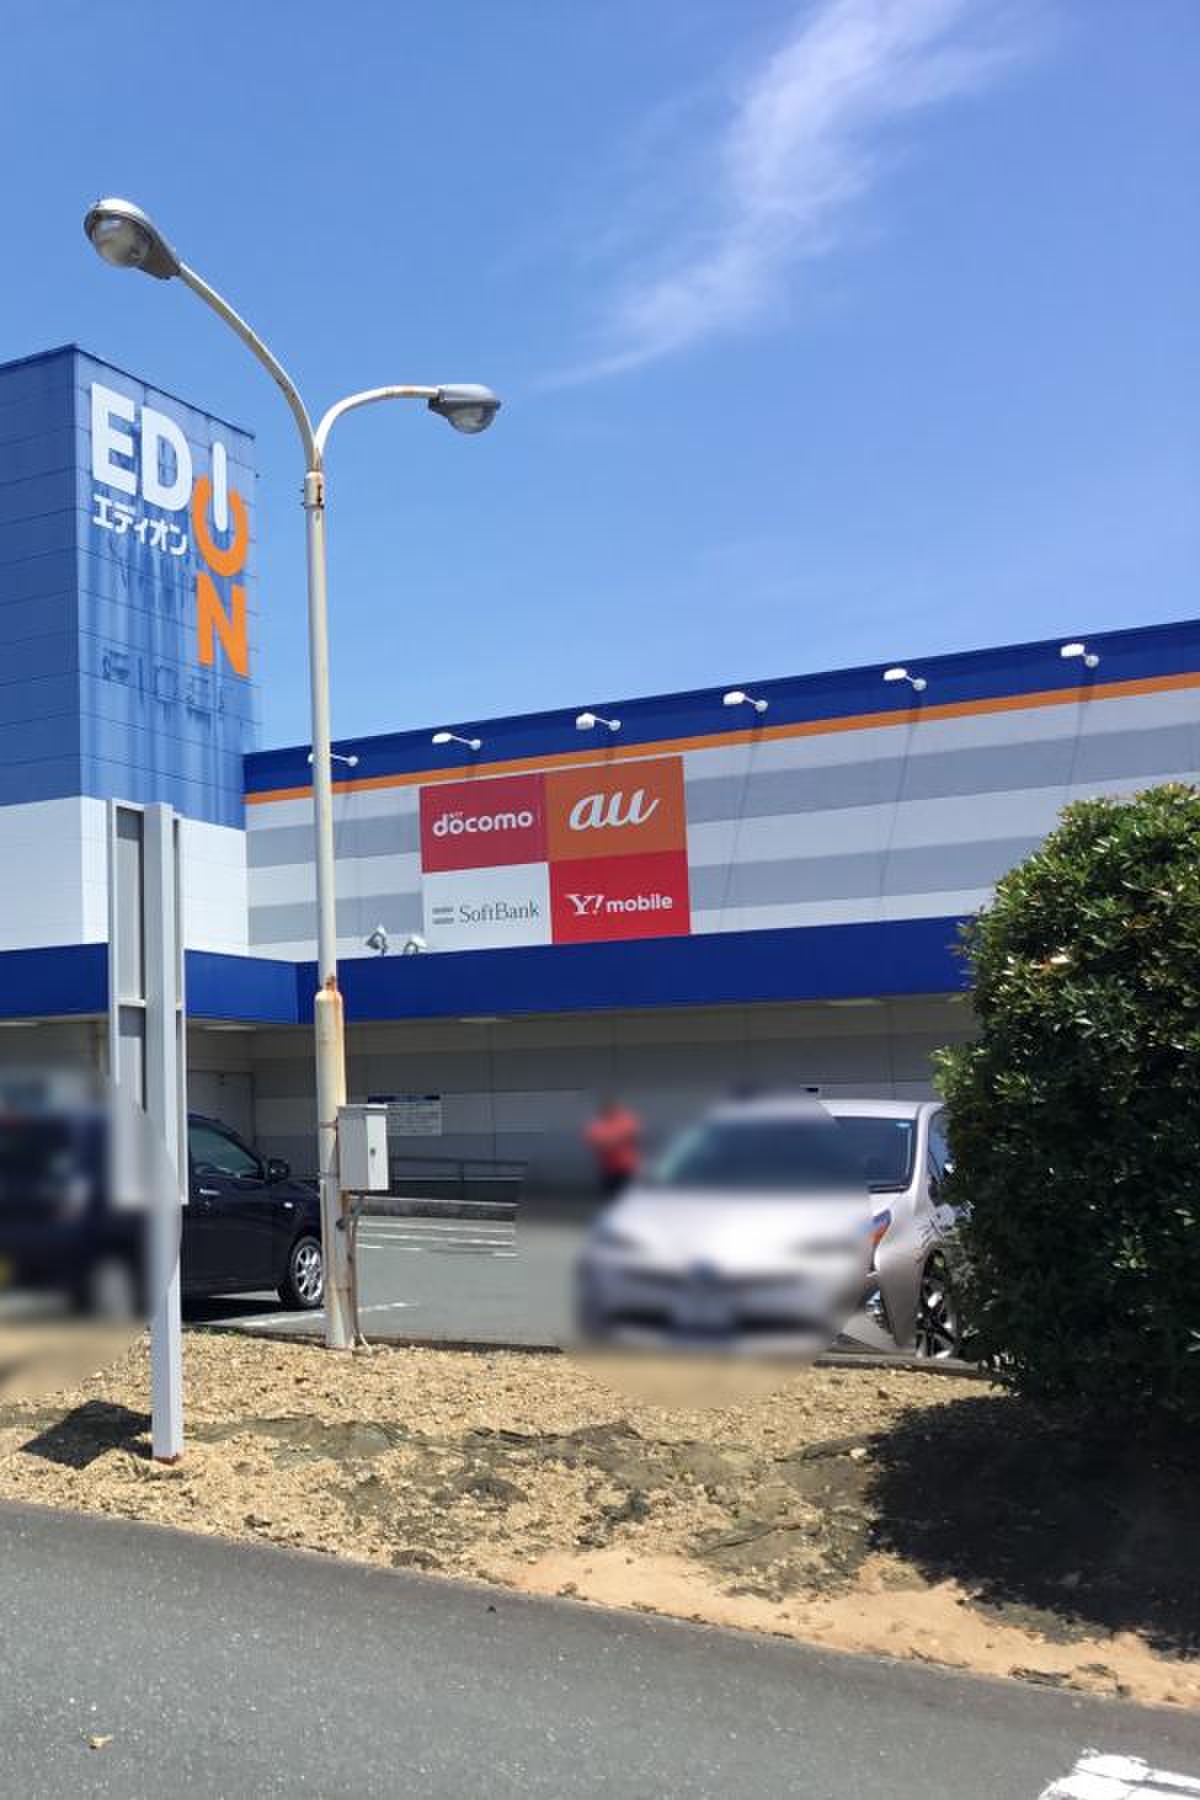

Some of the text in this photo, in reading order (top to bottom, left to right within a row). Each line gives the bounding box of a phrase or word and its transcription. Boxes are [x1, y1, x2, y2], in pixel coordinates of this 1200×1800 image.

[92, 494, 188, 556] エディオン
[432, 810, 534, 838] docomo
[568, 787, 660, 832] au
[458, 899, 540, 924] SoftBank
